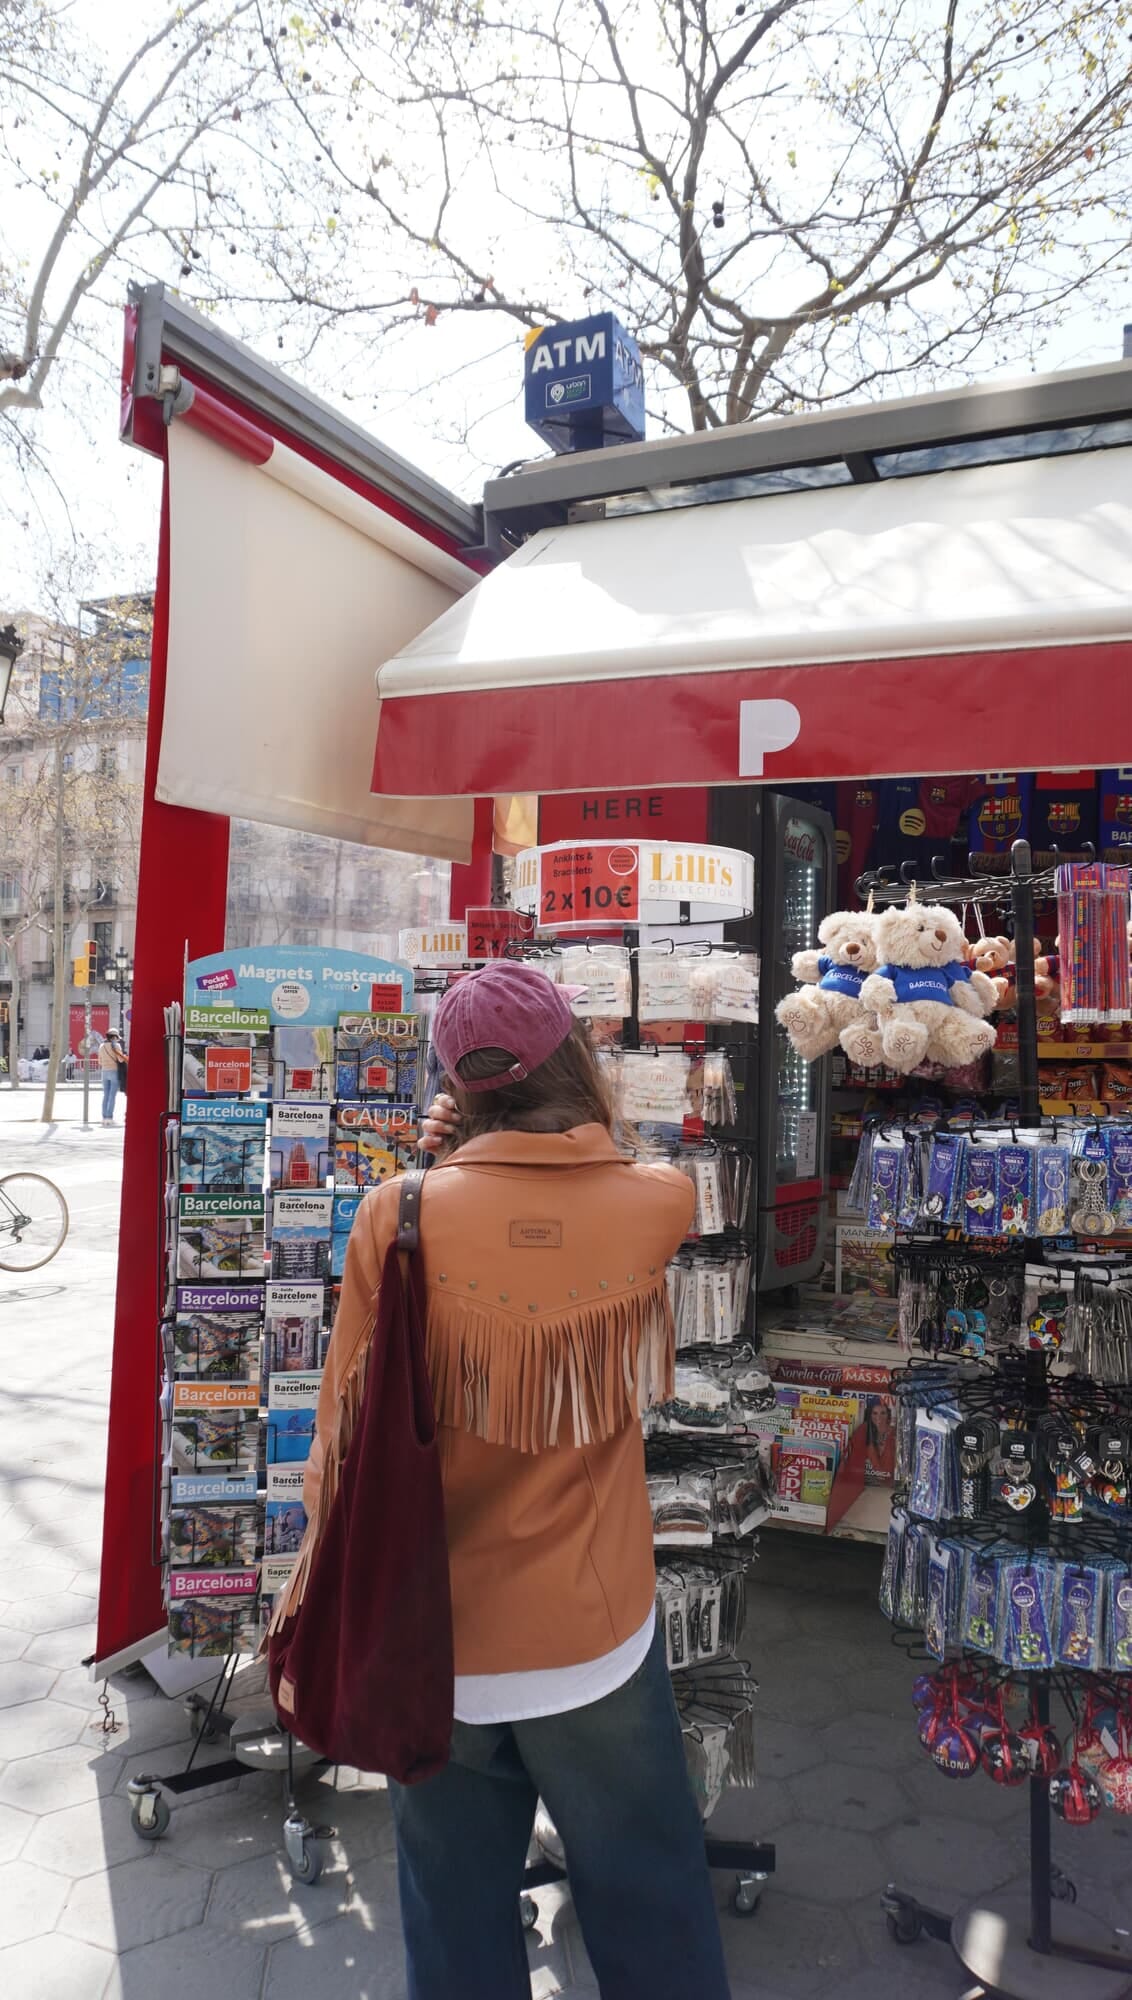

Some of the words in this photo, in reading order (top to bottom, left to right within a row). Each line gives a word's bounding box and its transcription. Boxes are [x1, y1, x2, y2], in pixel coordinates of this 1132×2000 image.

[531, 332, 606, 374] ATM
[739, 699, 801, 777] P
[583, 796, 664, 820] HERE
[553, 853, 585, 864] Anklets
[649, 852, 733, 887] Lilli's
[545, 890, 556, 912] 2
[562, 893, 573, 910] x
[581, 886, 632, 908] 10€
[421, 933, 466, 953] Lilli'
[474, 935, 485, 950] 2
[202, 974, 230, 986] Pocket
[239, 964, 313, 983] Magnets
[322, 968, 404, 983] Postcards
[207, 981, 228, 992] maps
[190, 1009, 268, 1025] Barcellona
[343, 1015, 418, 1037] GAUDÍ
[208, 1060, 250, 1068] Barcelona
[186, 1103, 264, 1118] Barcelona
[278, 1111, 324, 1120] Barcelona
[341, 1105, 417, 1127] GAUDÍ
[184, 1197, 262, 1210] Barcelona
[279, 1201, 325, 1210] Barcelona
[181, 1291, 259, 1305] Barcelone
[272, 1291, 318, 1300] Barcelone
[846, 1369, 872, 1383] MÁS
[179, 1387, 256, 1401] Barcelona
[803, 1397, 850, 1408] CRUZADAS
[803, 1421, 839, 1432] SOPAS
[806, 1430, 841, 1441] SOPAS
[795, 1457, 820, 1466] Mini
[176, 1481, 254, 1497] Barcelona
[175, 1576, 253, 1591] Barcelona
